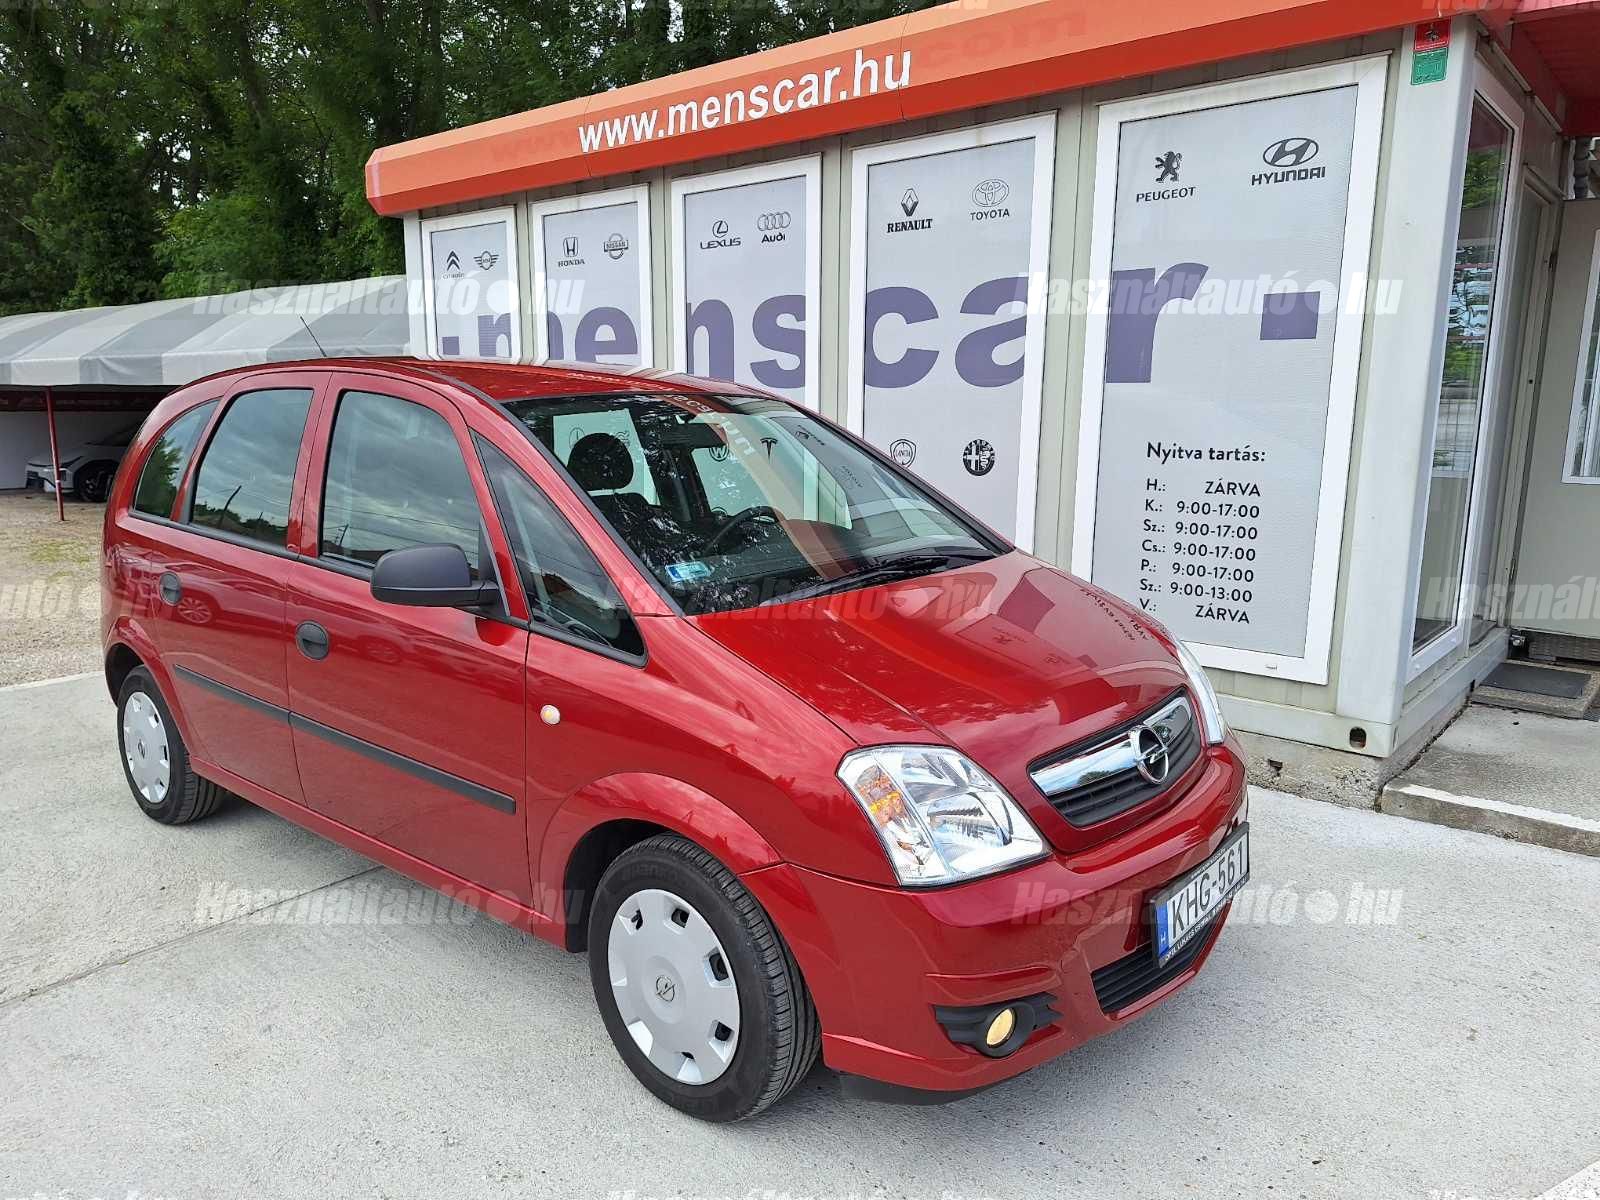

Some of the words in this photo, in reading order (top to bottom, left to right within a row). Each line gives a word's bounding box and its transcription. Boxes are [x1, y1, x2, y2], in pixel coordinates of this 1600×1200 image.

[578, 49, 912, 153] www.menscar.hu
[1251, 166, 1326, 186] HYUNDAI
[1136, 186, 1196, 202] PEUGEOT
[970, 208, 1010, 221] TOYOTA
[887, 218, 933, 233] RENAULT
[700, 237, 741, 249] LEXUS
[761, 233, 786, 244] Audi
[558, 258, 586, 268] HONDA
[1146, 442, 1202, 464] Nyitva
[1209, 445, 1266, 462] tartás:
[1146, 478, 1166, 491] H.:
[1204, 478, 1261, 497] ZÁRVA
[1145, 499, 1163, 512] K.:
[1176, 500, 1260, 518] 9:00-17:00
[1143, 519, 1165, 533] Sz.:
[1175, 521, 1258, 540] 9:00-17:00
[1141, 539, 1166, 553] Cs.:
[1173, 542, 1256, 561] 9:00-17:00
[1140, 559, 1156, 572] P.:
[1172, 562, 1254, 582] 9:00-17:00
[1139, 579, 1162, 592] Sz.:
[1170, 582, 1252, 603] 9:00-13:00
[1139, 598, 1157, 612] V.:
[1195, 603, 1250, 624] ZÁRVA
[1172, 840, 1244, 939] KHG-561
